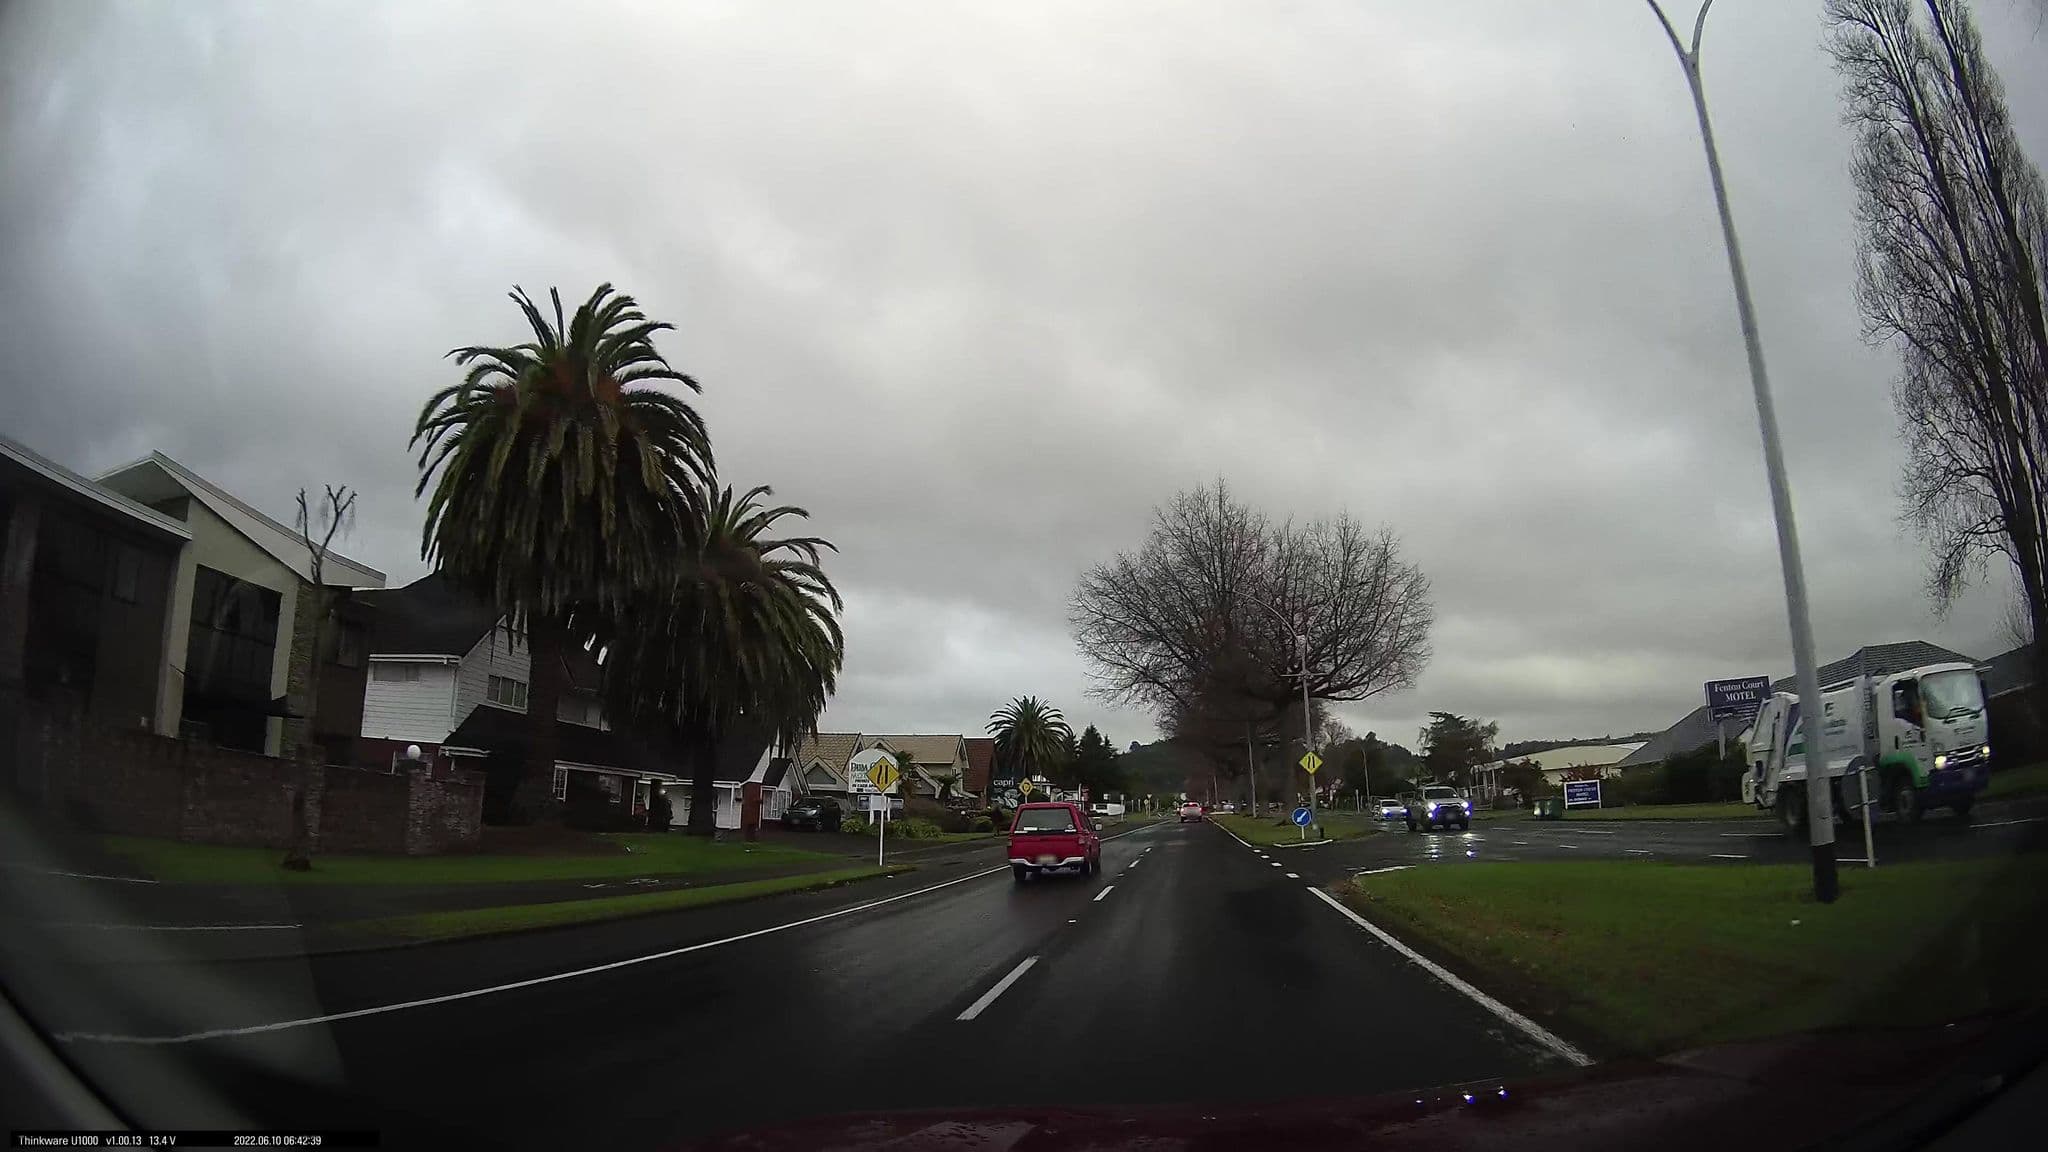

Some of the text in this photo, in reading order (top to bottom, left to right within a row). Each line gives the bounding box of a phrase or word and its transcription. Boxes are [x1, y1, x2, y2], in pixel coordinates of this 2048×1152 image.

[1714, 680, 1764, 692] Fenton Court
[1725, 690, 1757, 702] MOTEL
[993, 776, 1014, 788] capri
